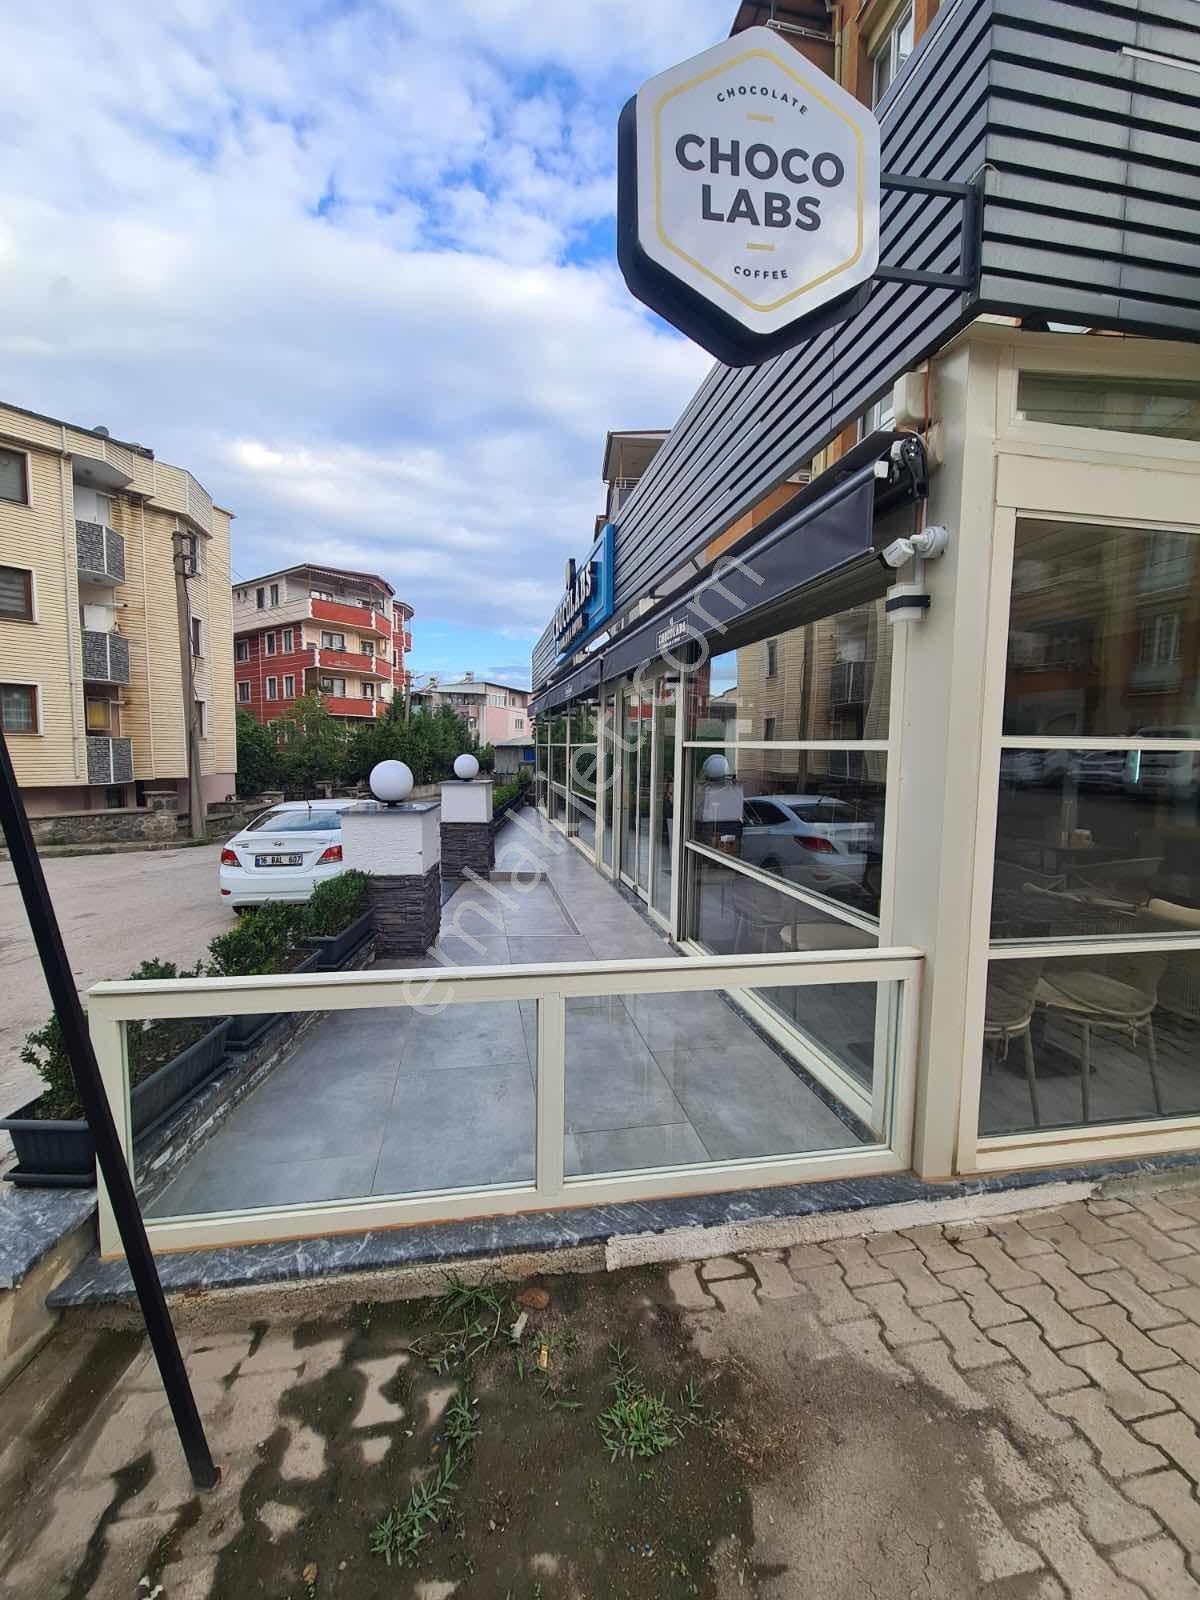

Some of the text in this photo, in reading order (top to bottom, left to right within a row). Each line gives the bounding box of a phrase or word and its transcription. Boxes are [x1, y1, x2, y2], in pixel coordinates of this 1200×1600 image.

[717, 85, 808, 115] CHOCOLATE
[675, 134, 845, 188] CHOCO
[701, 183, 822, 232] LABS
[733, 265, 788, 280] COFFEE
